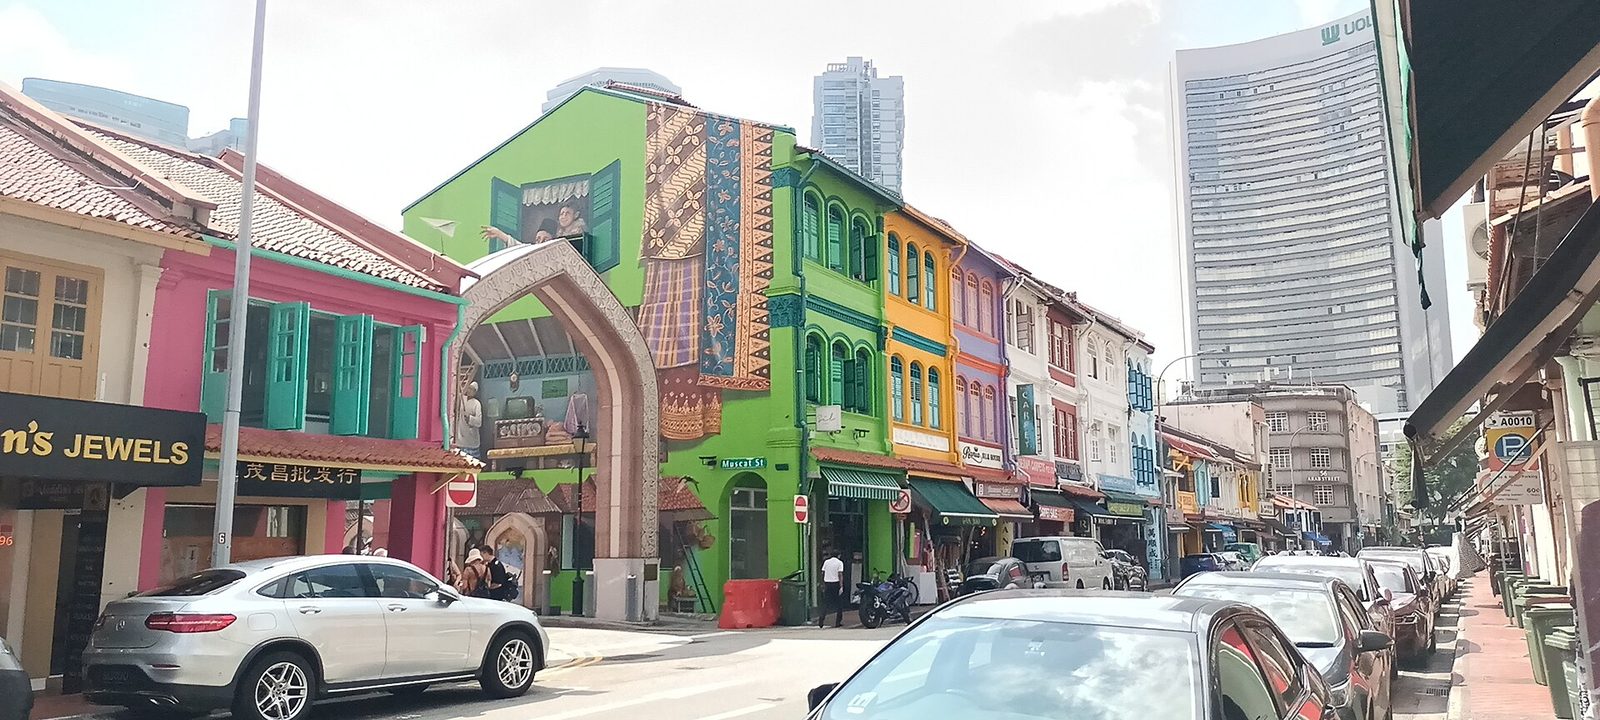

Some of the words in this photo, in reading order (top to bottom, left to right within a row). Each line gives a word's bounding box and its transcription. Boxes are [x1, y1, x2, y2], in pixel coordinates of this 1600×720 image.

[1344, 16, 1372, 35] UOL
[1022, 391, 1031, 448] CARPET
[1501, 417, 1533, 426] A0010
[63, 433, 189, 465] JEWELS
[722, 459, 752, 468] Muscat
[755, 458, 764, 467] St
[235, 463, 357, 485] 茂昌批发行
[219, 533, 225, 544] 6
